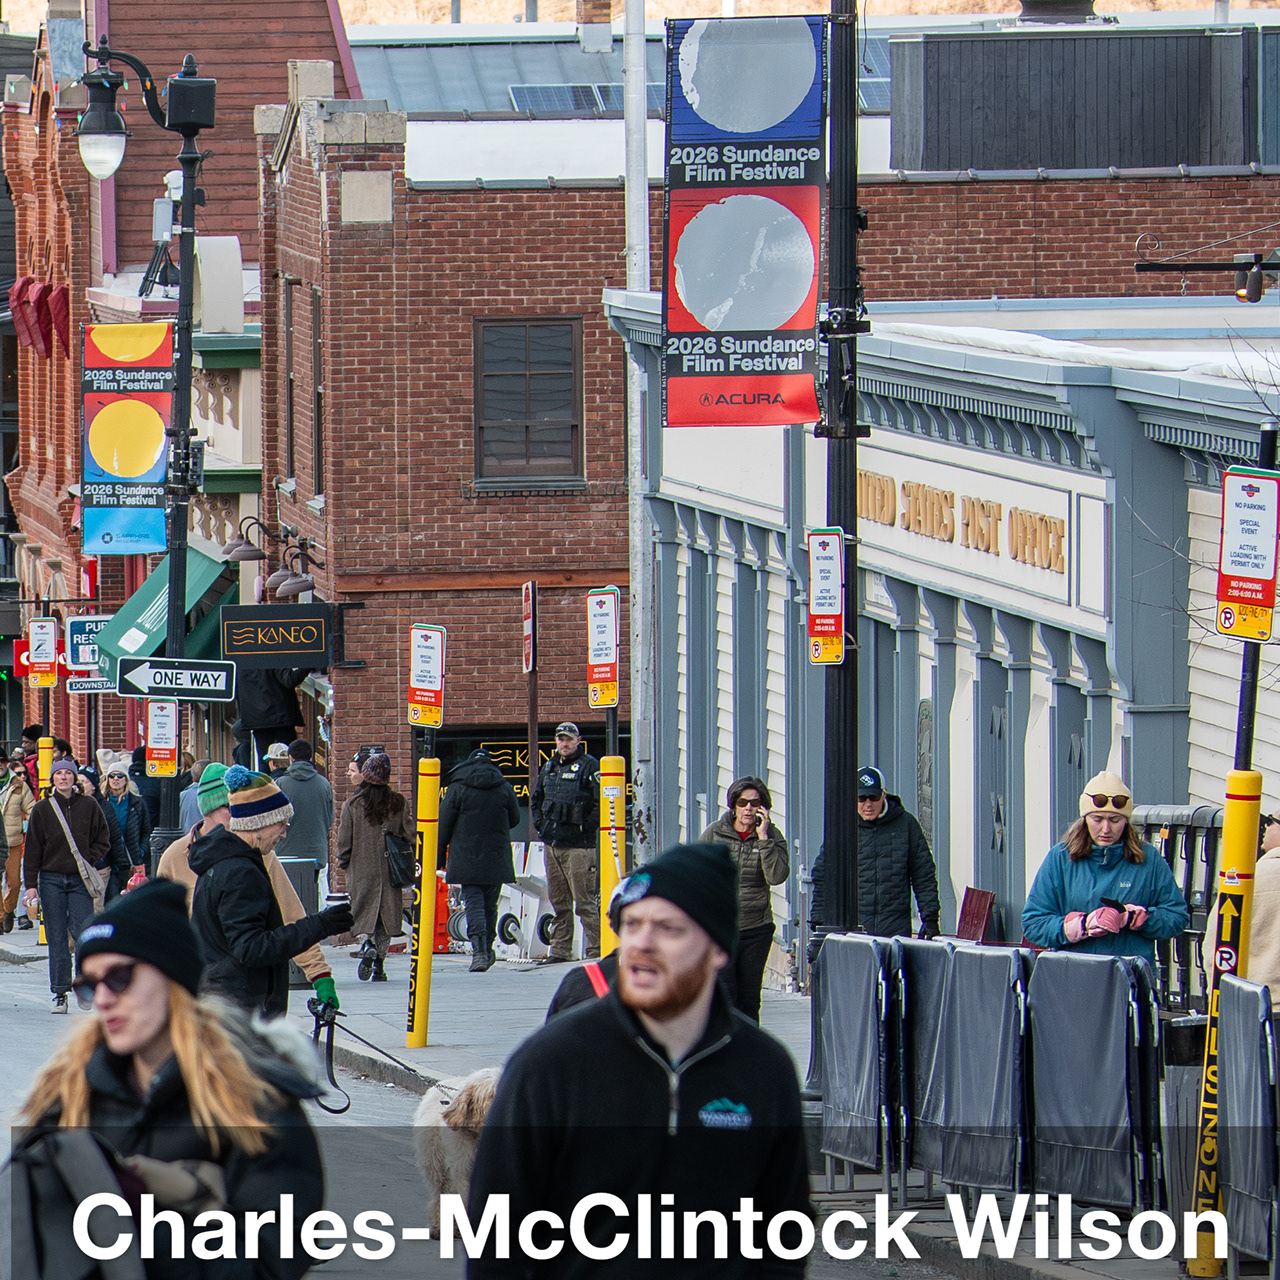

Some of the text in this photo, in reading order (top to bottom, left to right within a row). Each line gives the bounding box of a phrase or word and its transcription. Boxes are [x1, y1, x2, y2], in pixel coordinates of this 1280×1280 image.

[669, 145, 820, 165] 2026 Sundance
[685, 162, 805, 182] Film Festival
[667, 336, 815, 355] 2026 Sundance
[682, 353, 803, 372] Film Festival
[85, 370, 173, 381] 2026 Sundance
[93, 380, 164, 390] Film Festival
[715, 393, 786, 405] ACURA
[84, 484, 164, 495] 2026 Sundance
[93, 494, 157, 505] Film Festival
[1243, 503, 1266, 511] PARKING
[900, 480, 955, 543] STATES
[960, 495, 1002, 557] POST
[1008, 506, 1065, 574] OFFICE
[1239, 519, 1260, 527] SPECIAL
[1241, 527, 1258, 535] EVENT
[1239, 544, 1258, 552] ACTIVE
[1230, 551, 1252, 560] LOADING
[1231, 559, 1265, 570] PERMIT ONLY
[1239, 582, 1262, 590] PARKING
[1227, 589, 1251, 598] 2:00-6:00
[258, 625, 318, 645] KANEO
[153, 670, 222, 687] ONE WAY
